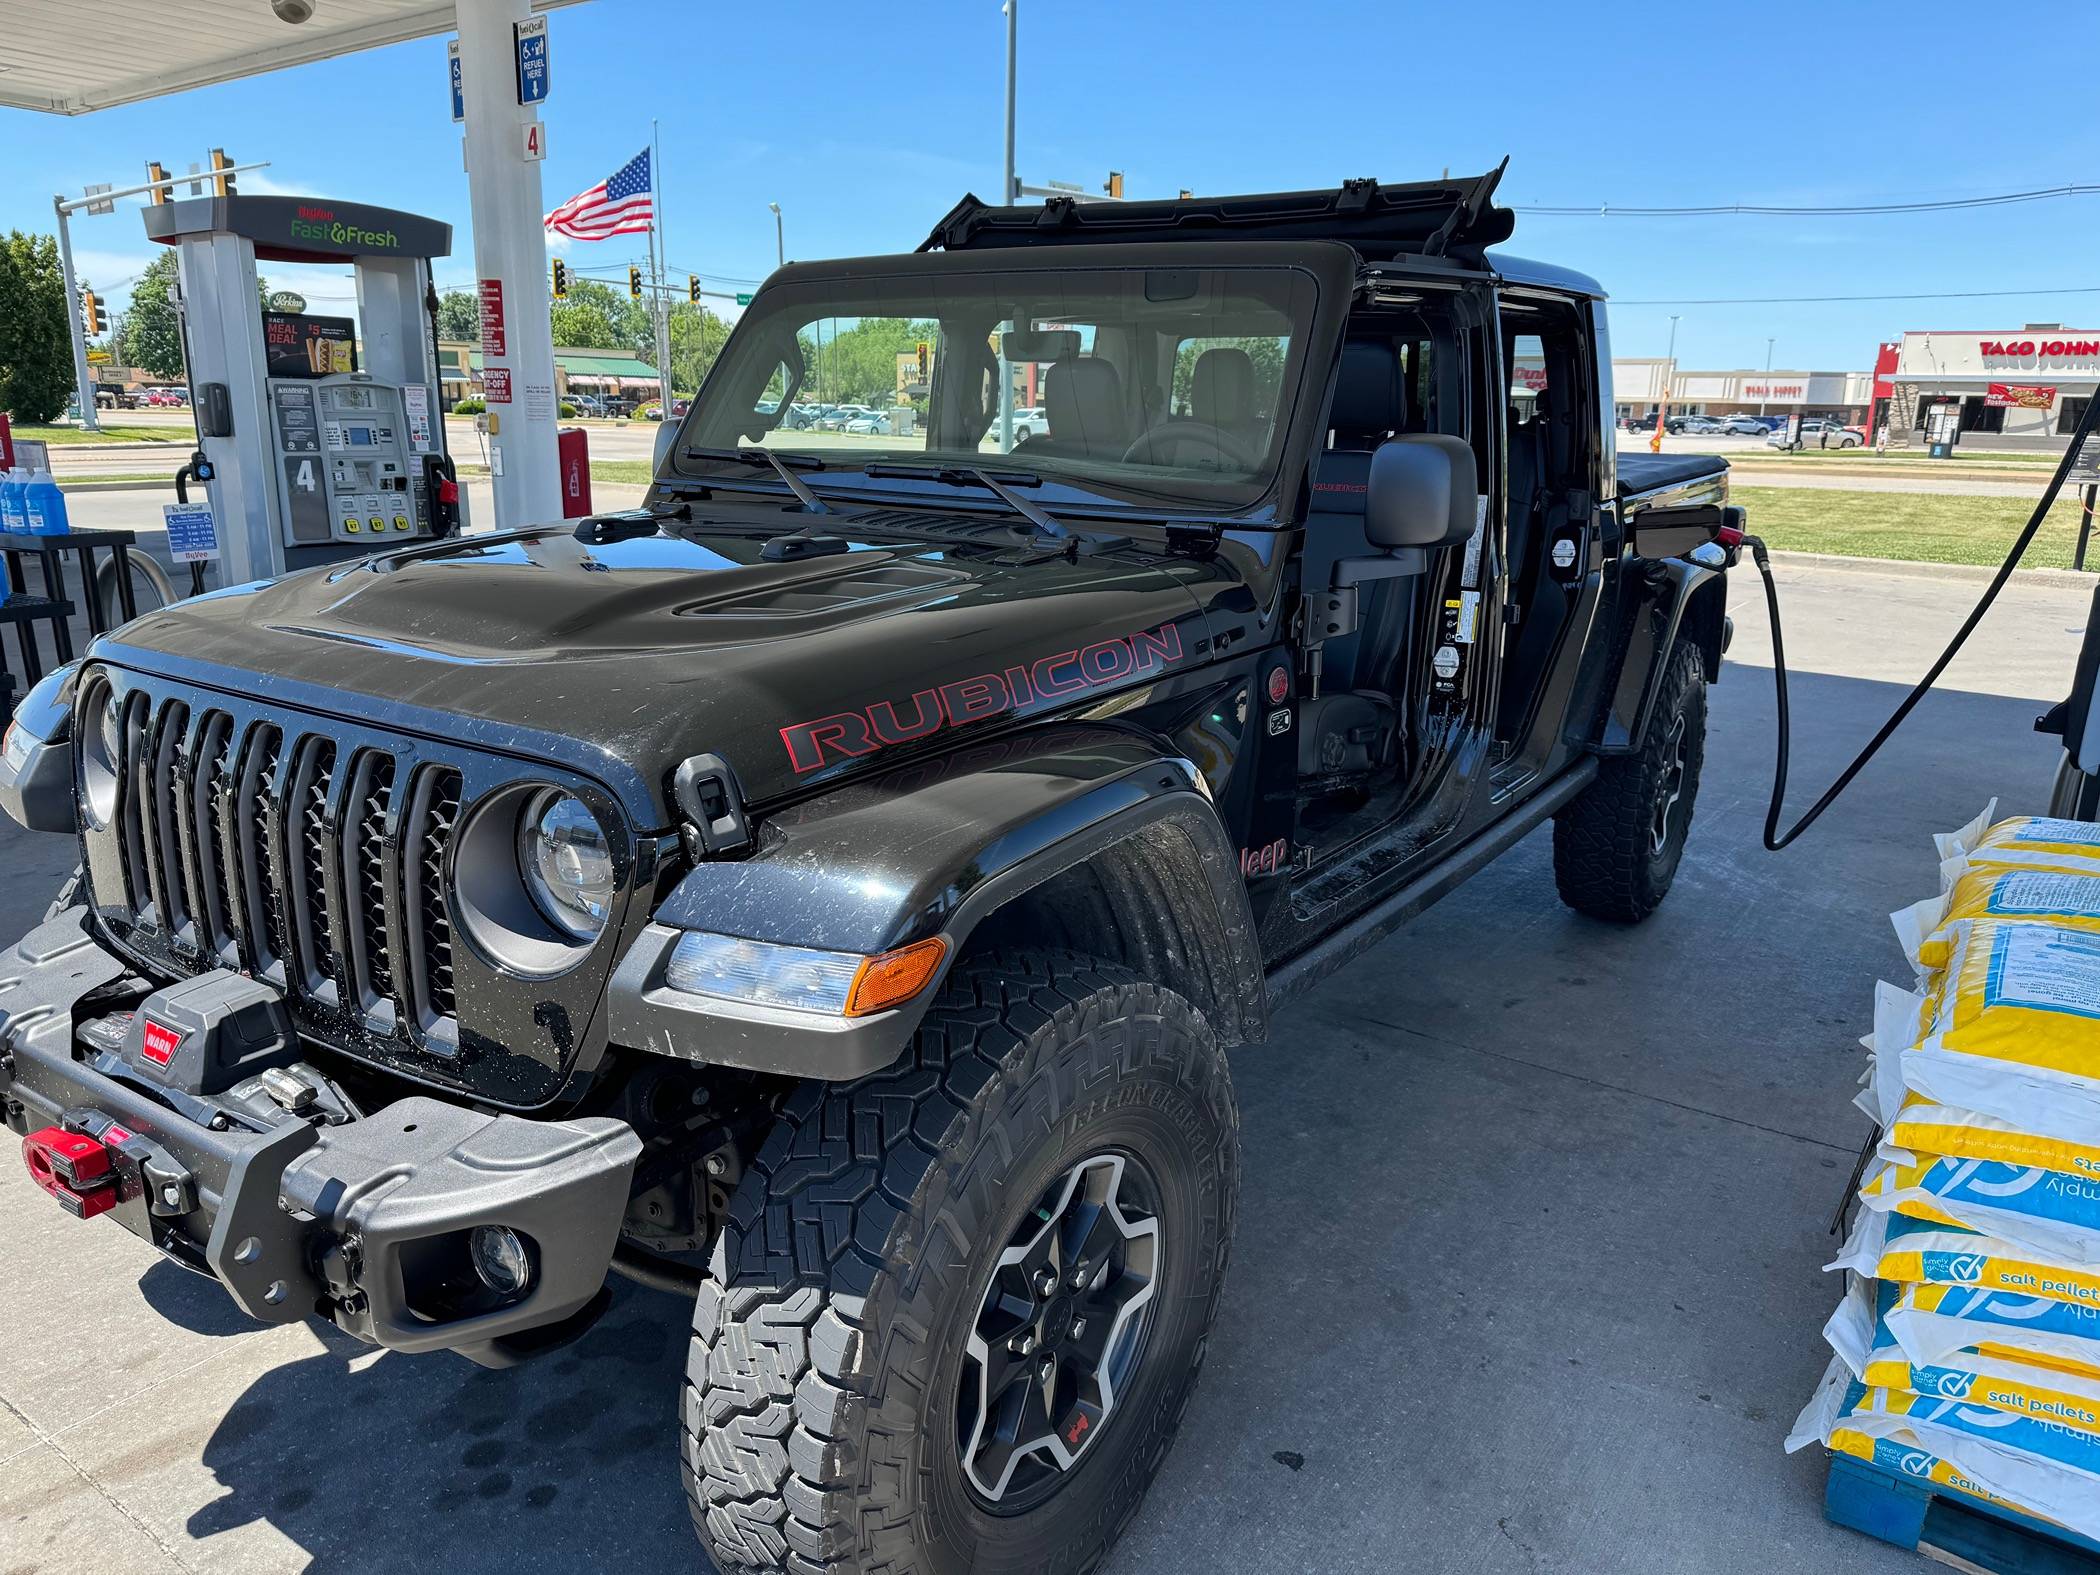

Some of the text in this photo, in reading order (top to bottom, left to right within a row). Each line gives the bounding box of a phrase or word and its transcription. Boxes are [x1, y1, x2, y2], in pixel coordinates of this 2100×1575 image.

[523, 59, 545, 71] REFUEL
[527, 70, 543, 79] HERE
[528, 127, 539, 155] 4
[273, 293, 303, 308] Perkins
[268, 324, 298, 335] MEAL
[268, 334, 297, 345] DEAL
[1980, 341, 2037, 356] TACO
[297, 460, 315, 491] 4
[779, 623, 1184, 774] RUBICON
[1241, 838, 1287, 877] Jeep
[146, 1033, 171, 1053] WARN
[2000, 1273, 2037, 1287] salt
[1988, 1390, 2096, 1424] salt pellets
